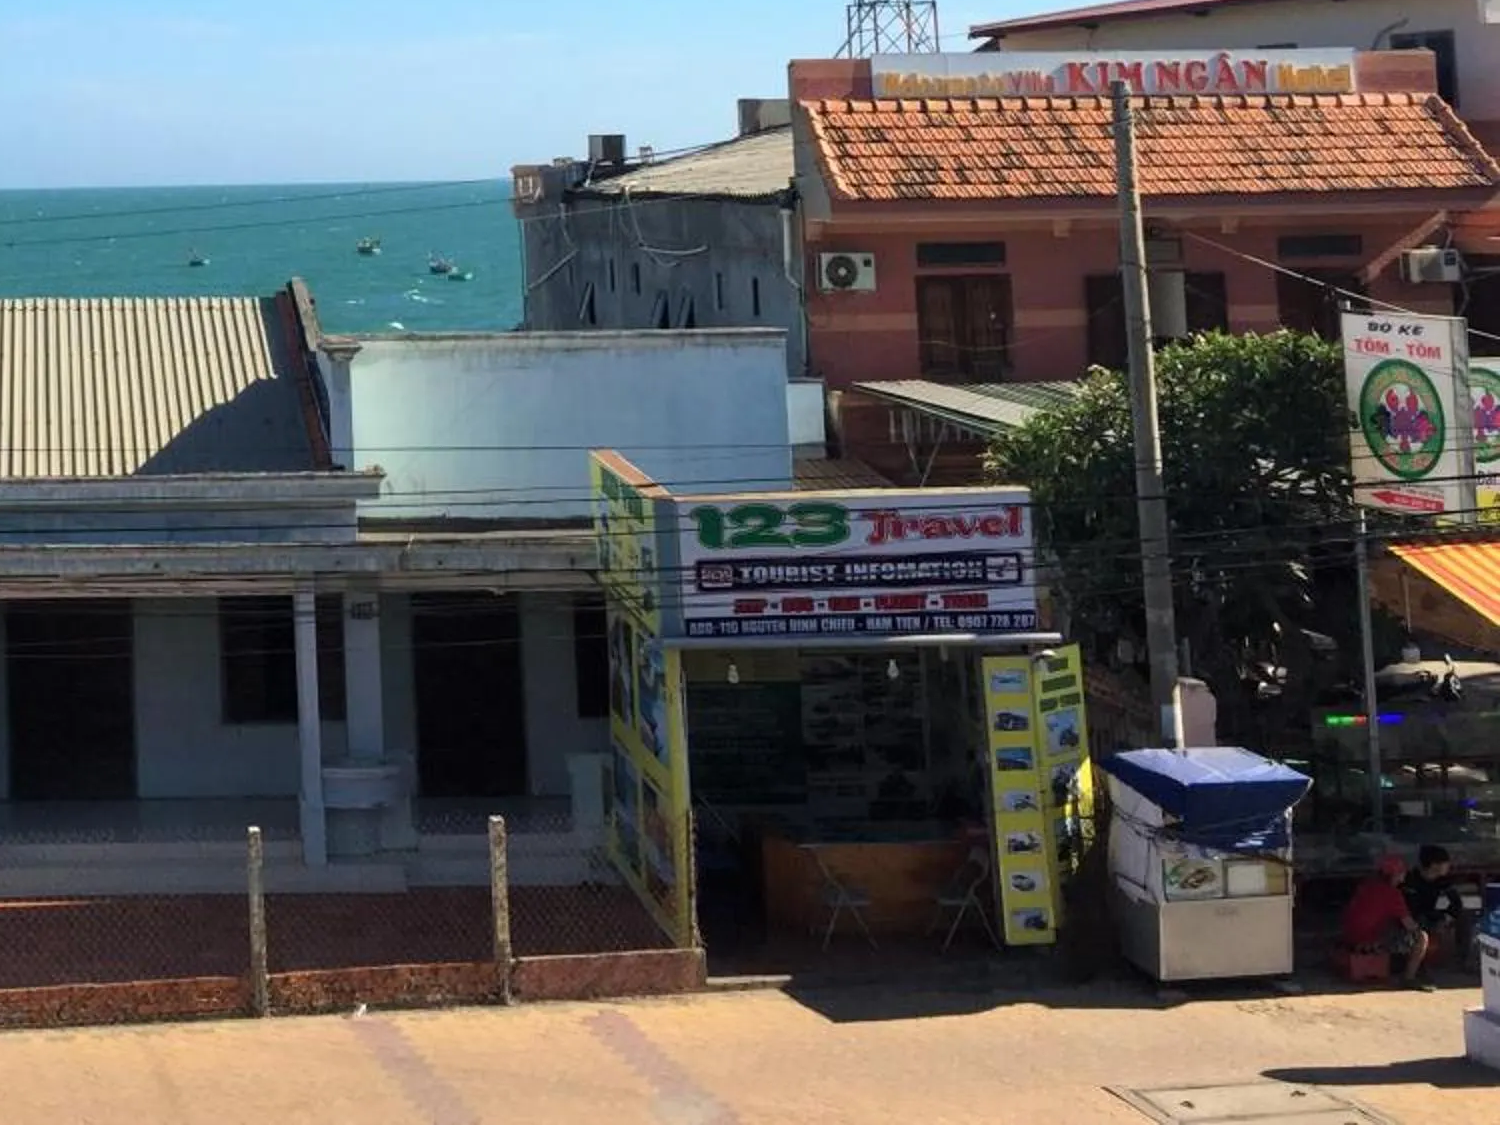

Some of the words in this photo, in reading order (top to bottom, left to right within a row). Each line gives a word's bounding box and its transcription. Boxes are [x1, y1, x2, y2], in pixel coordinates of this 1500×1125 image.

[1066, 62, 1144, 92] KIM
[1155, 52, 1268, 92] NGÂN
[690, 502, 850, 549] 123
[861, 505, 1024, 544] Travel
[739, 564, 836, 584] TOURIST
